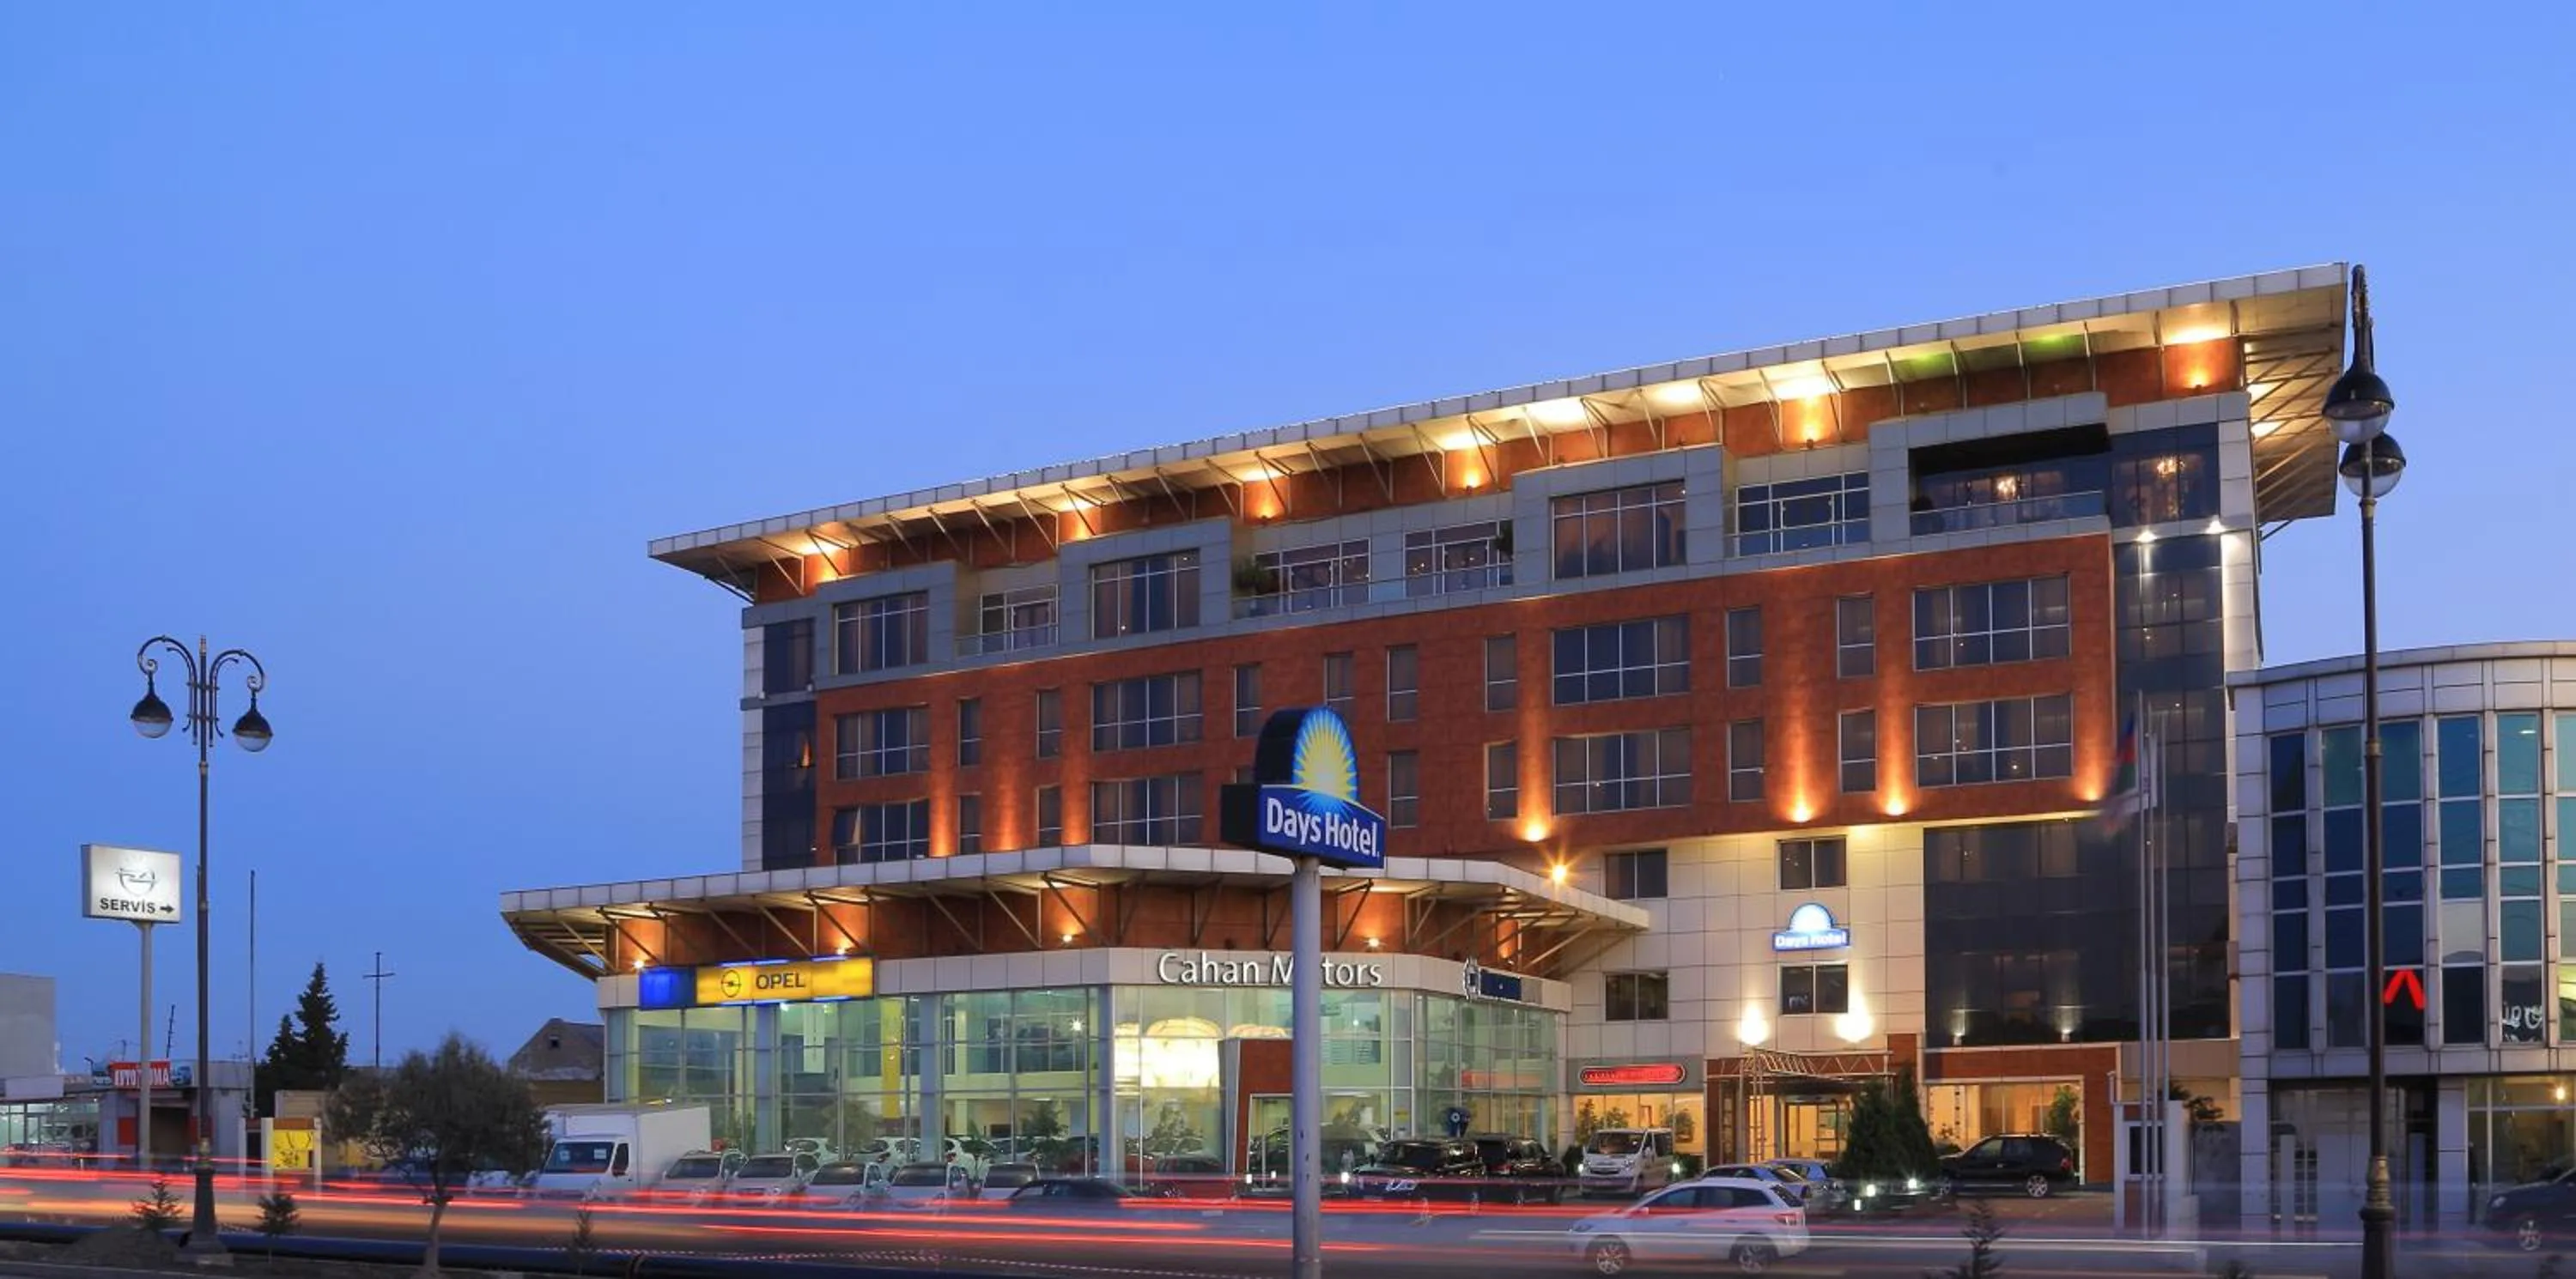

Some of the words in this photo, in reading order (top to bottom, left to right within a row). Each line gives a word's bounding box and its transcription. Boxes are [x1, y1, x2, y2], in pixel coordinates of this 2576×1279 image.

[1267, 797, 1321, 846] Days
[1325, 811, 1378, 858] Hotel
[755, 973, 806, 990] OPEL
[1159, 952, 1260, 984] Cahan
[1270, 955, 1382, 986] Mtors
